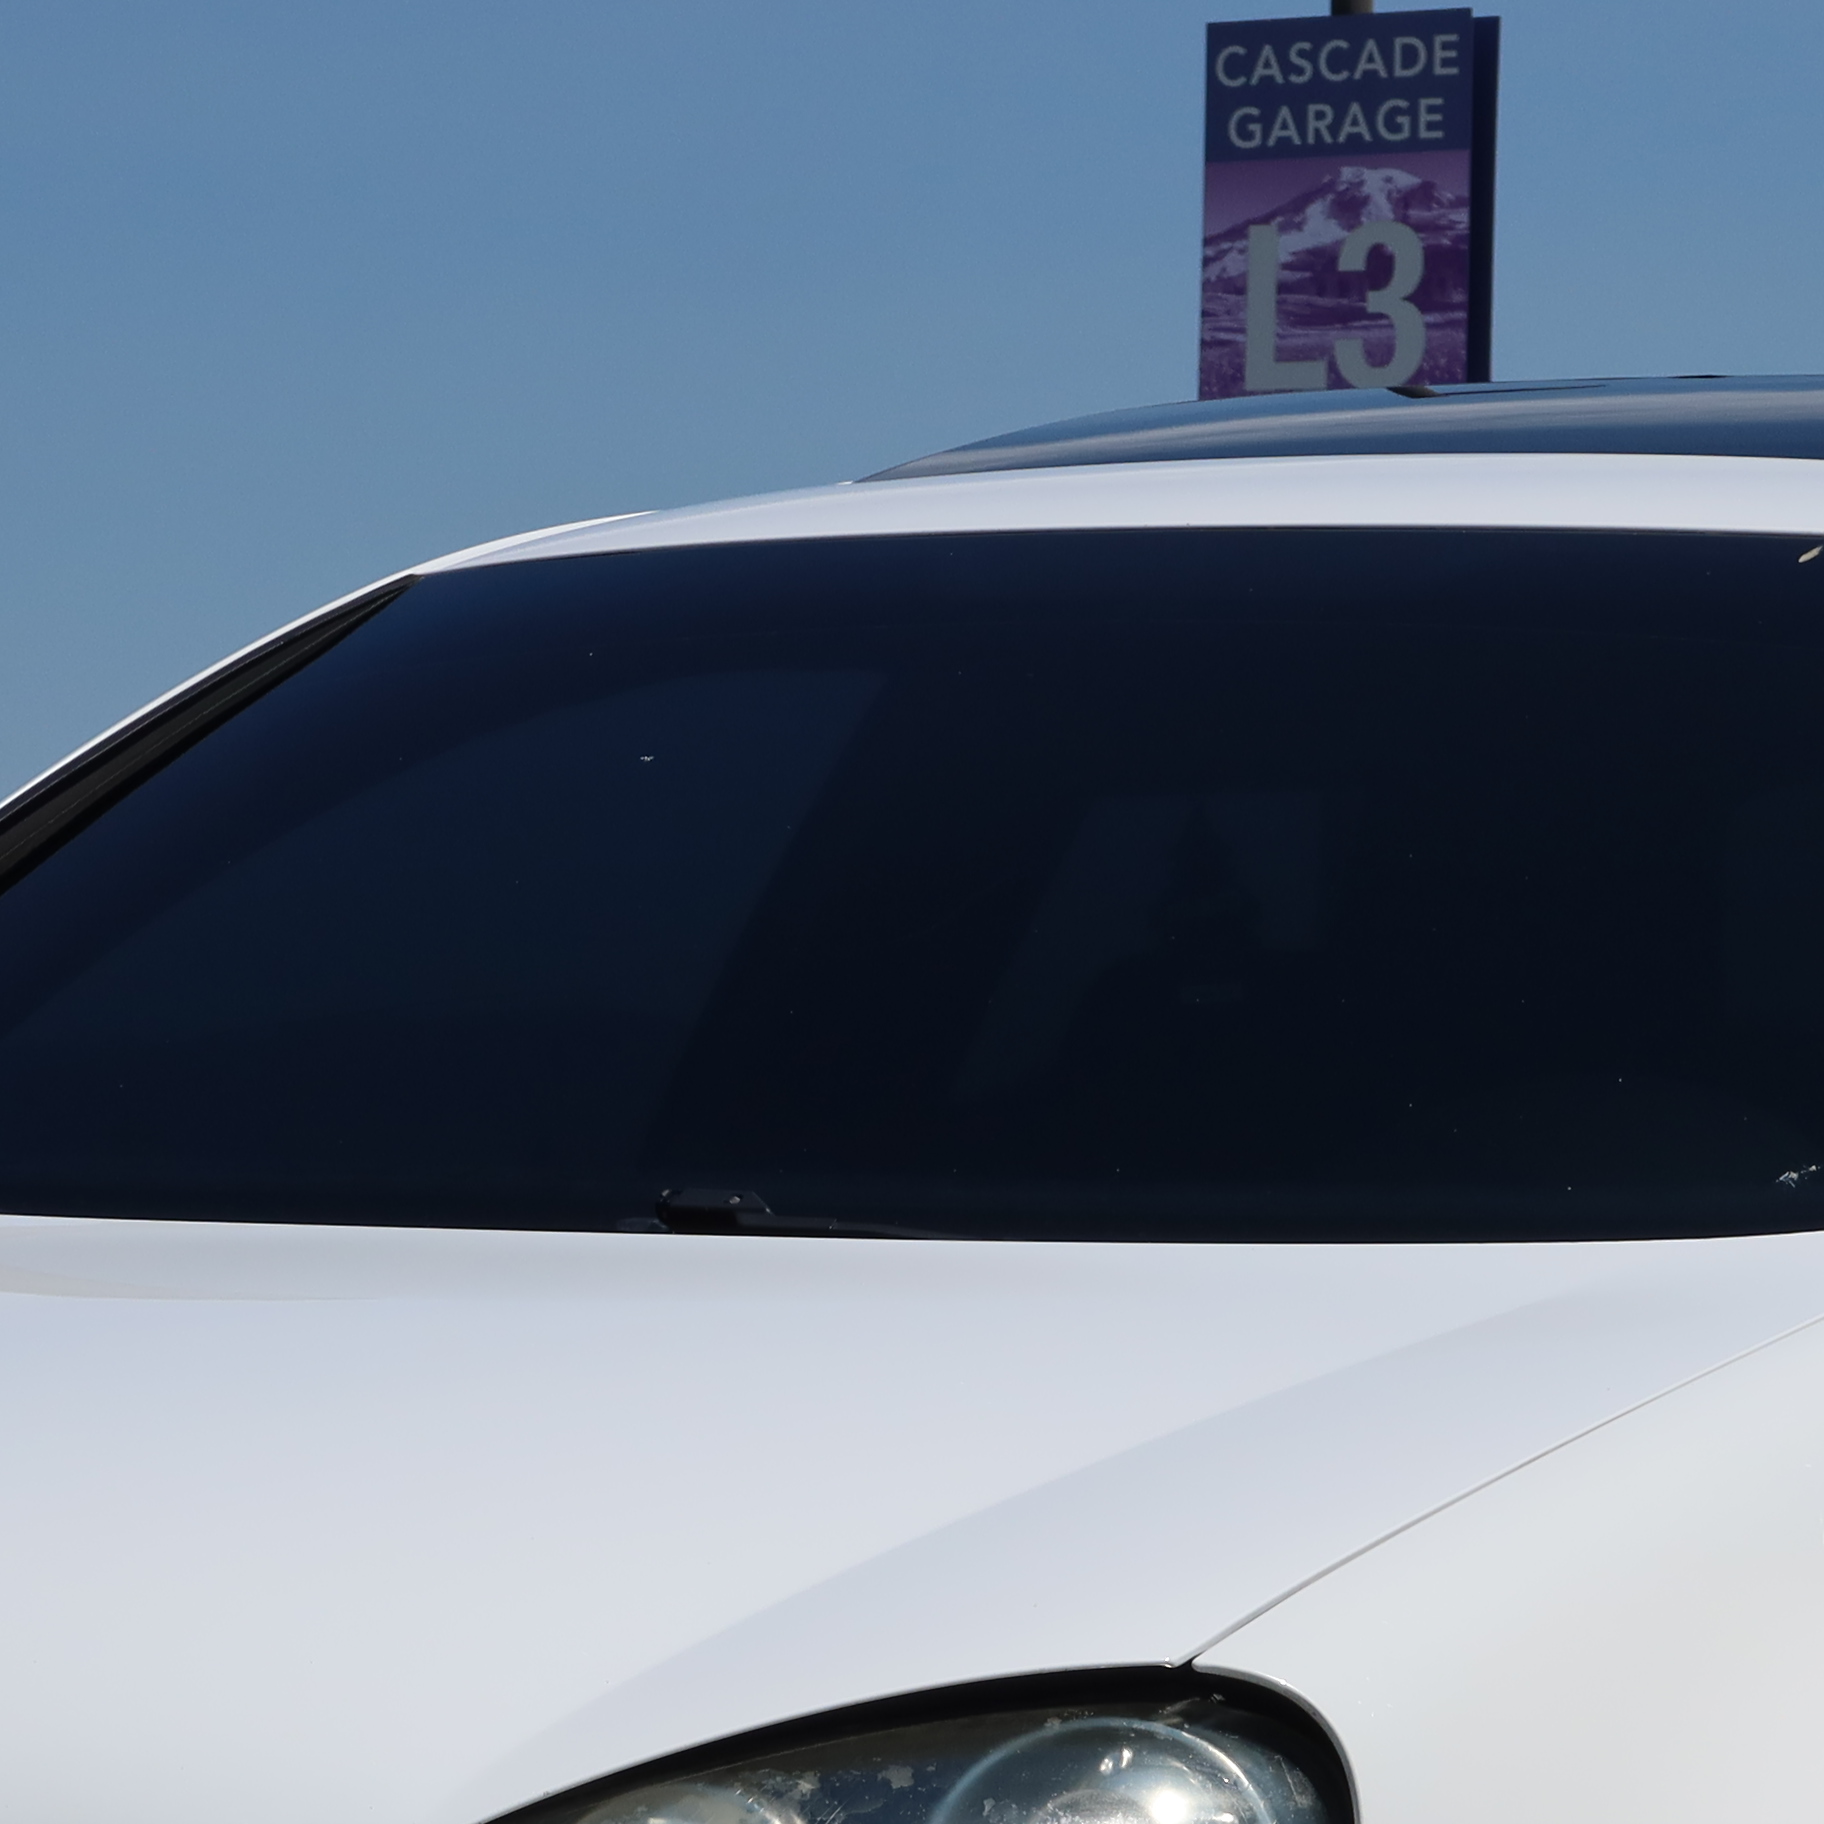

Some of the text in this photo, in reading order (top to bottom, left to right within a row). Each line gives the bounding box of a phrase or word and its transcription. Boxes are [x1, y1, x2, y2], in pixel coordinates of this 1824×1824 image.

[1214, 33, 1460, 87] CASCADE
[1227, 97, 1445, 149] GARAGE
[1244, 220, 1427, 391] L3
